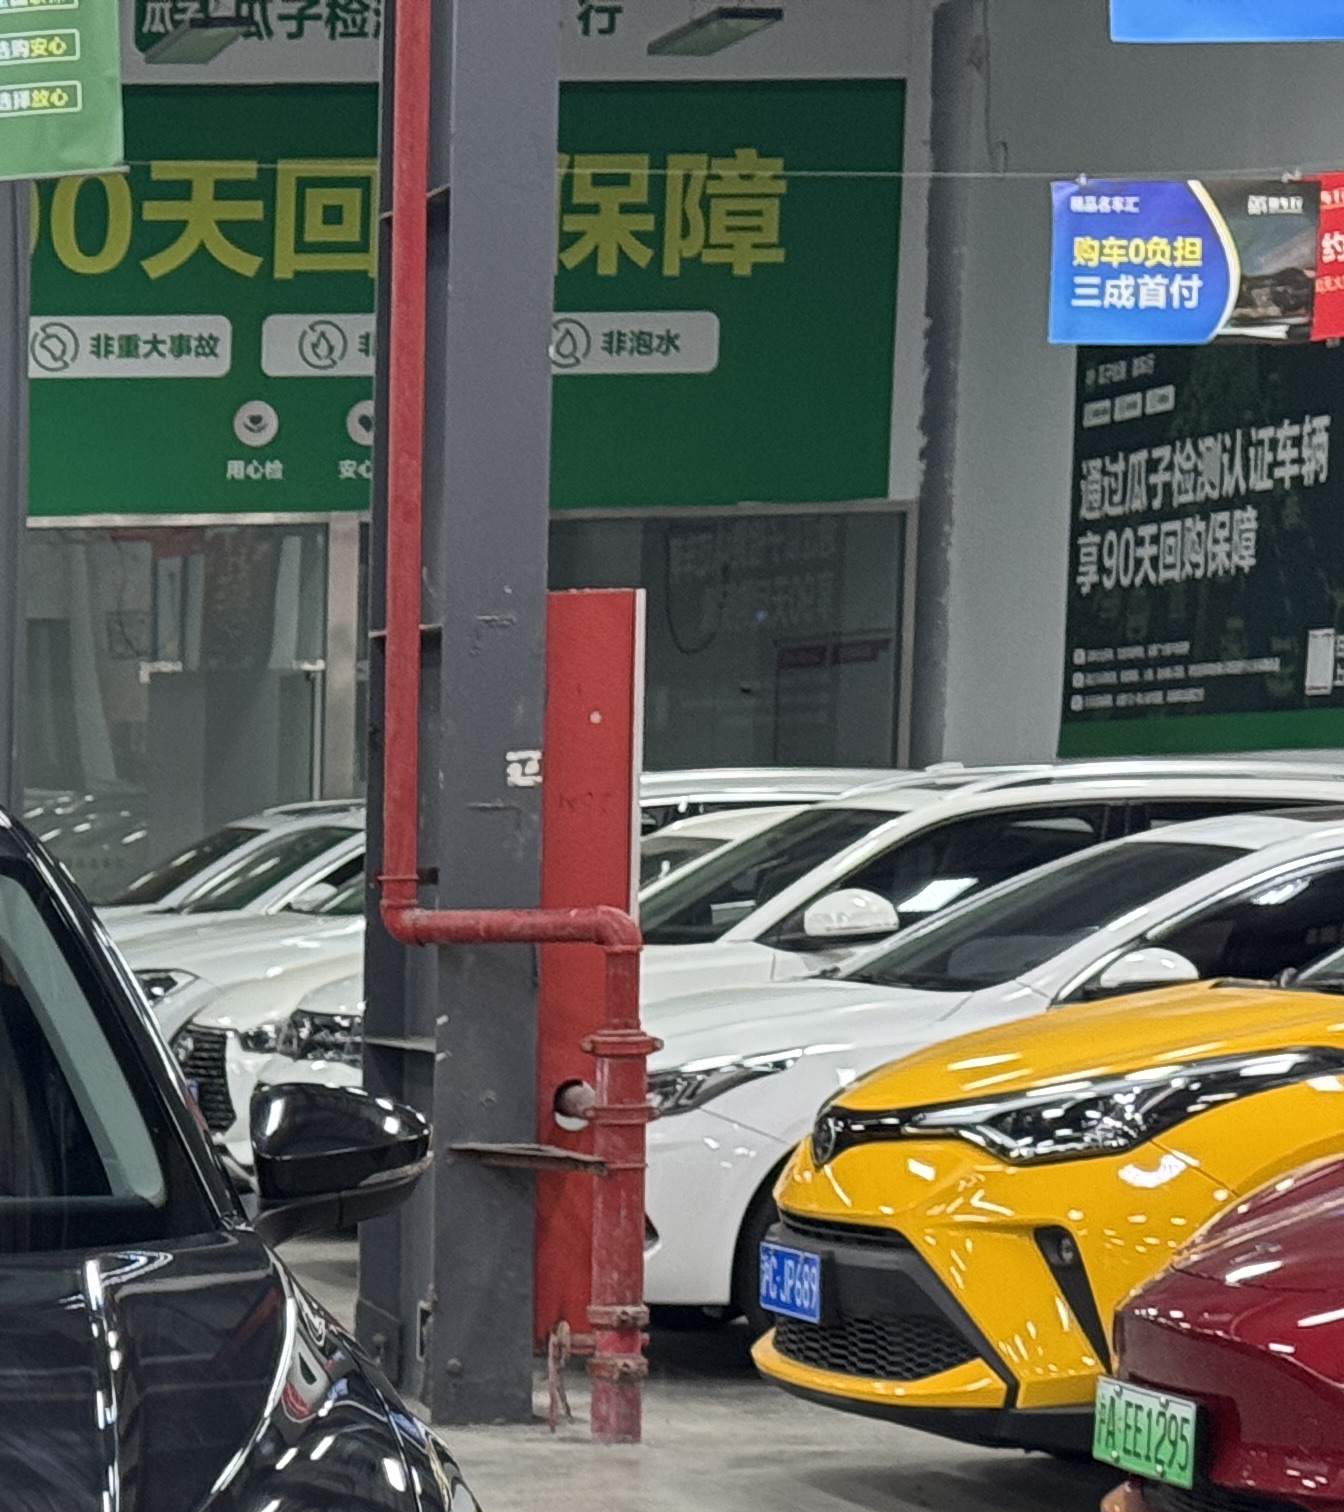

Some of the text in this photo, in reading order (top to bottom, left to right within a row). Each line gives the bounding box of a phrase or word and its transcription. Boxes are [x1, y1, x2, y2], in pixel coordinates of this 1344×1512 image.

[1073, 236, 1203, 268] 购车0负担
[1071, 273, 1203, 310] 三成首付
[89, 333, 220, 360] 非重大事故
[601, 328, 681, 356] 非泡水
[226, 459, 283, 480] 用心检
[337, 459, 373, 480] 安心
[1079, 415, 1331, 520] 通过瓜子检测认证车辆
[1076, 504, 1258, 596] 享90天回购保障
